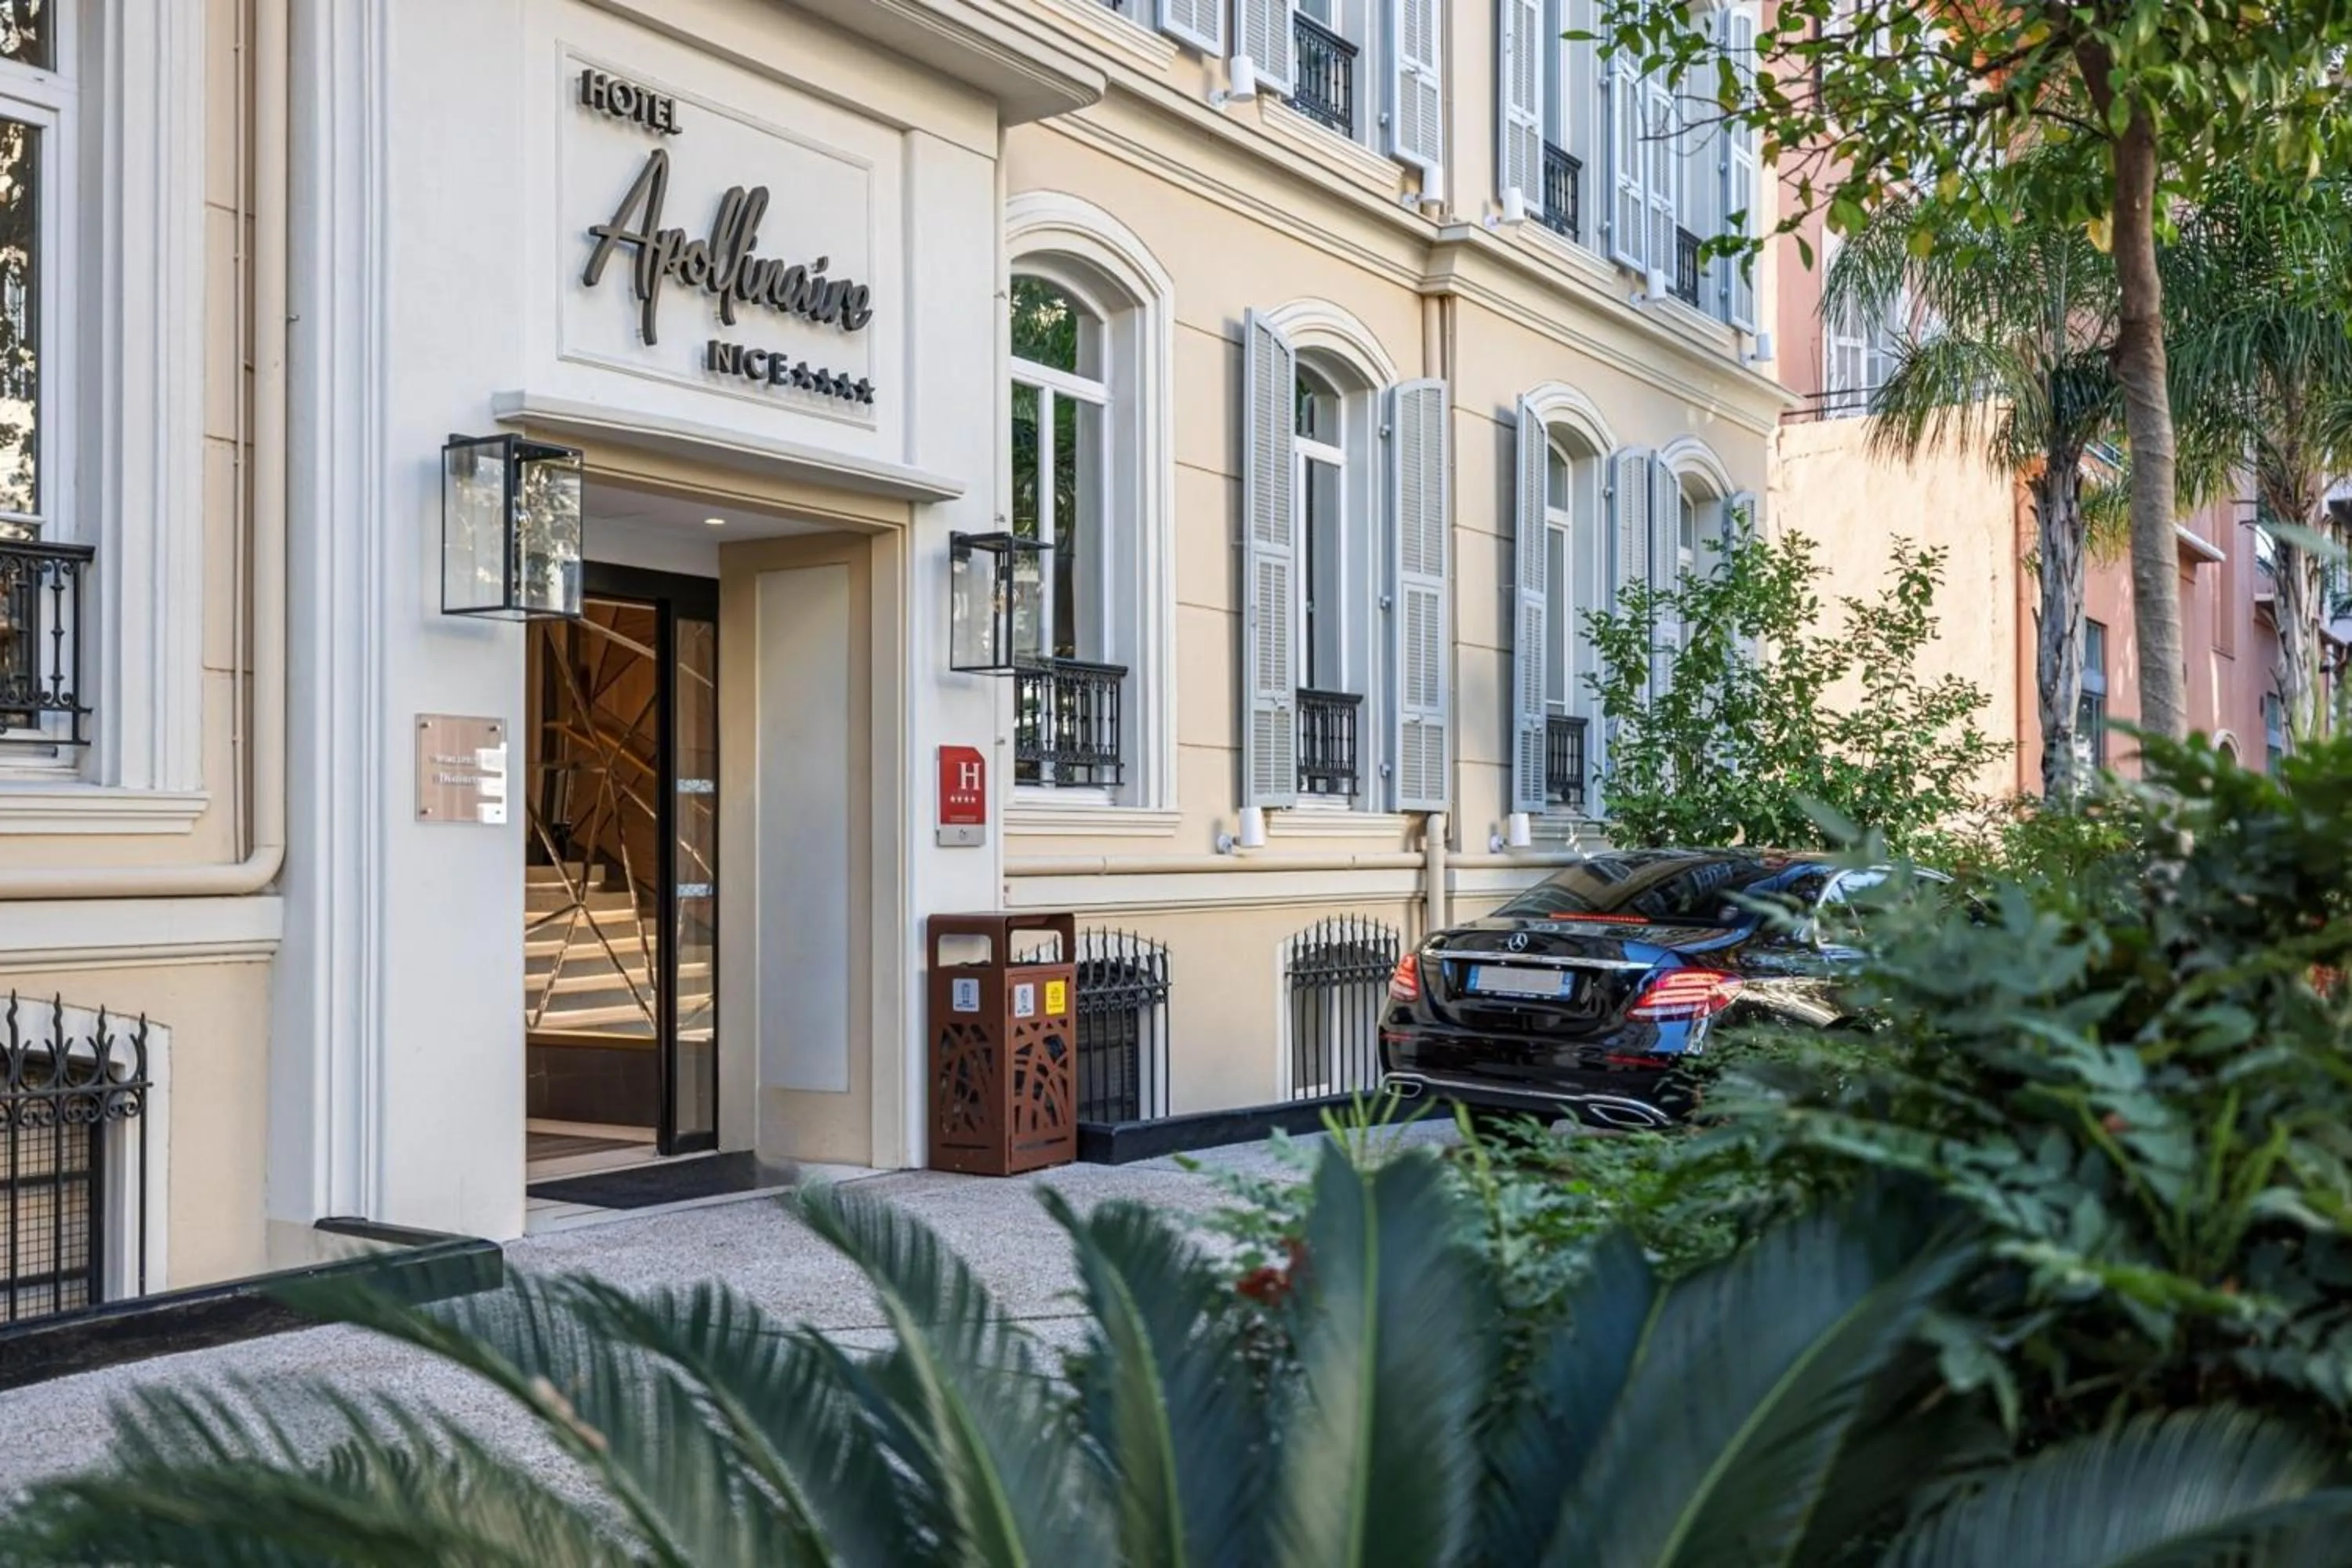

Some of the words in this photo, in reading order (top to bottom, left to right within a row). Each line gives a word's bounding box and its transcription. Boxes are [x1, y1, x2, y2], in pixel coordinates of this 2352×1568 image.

[582, 69, 683, 135] HOTEL
[583, 148, 873, 345] Apollinaire
[707, 339, 788, 385] NICE
[959, 761, 981, 790] H
